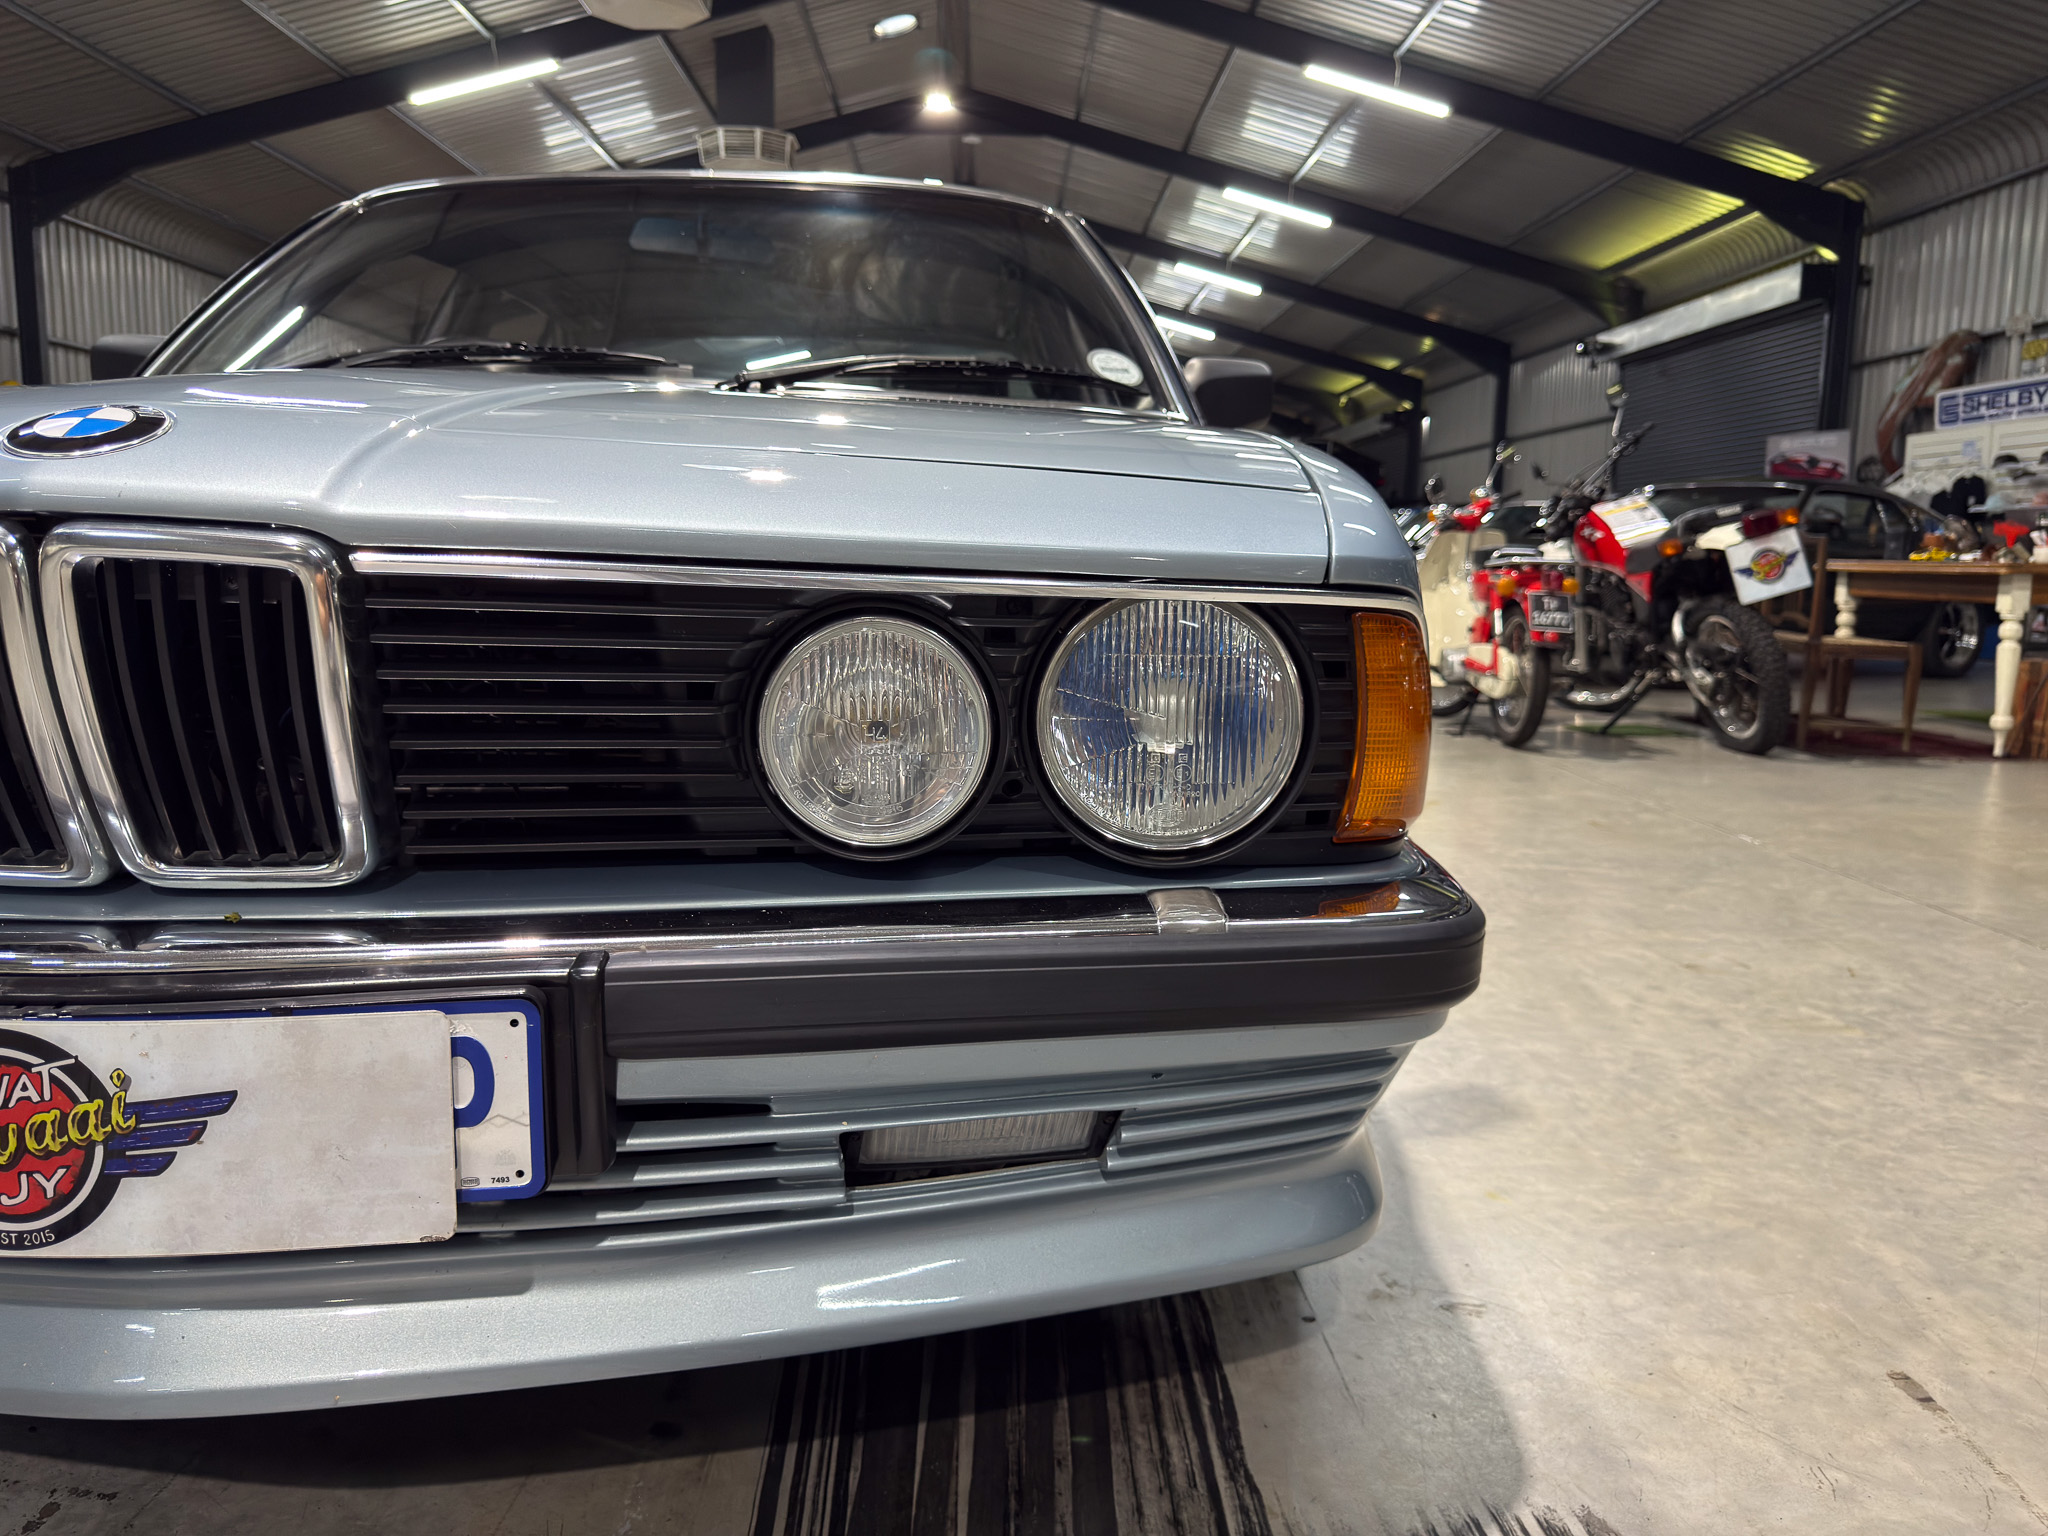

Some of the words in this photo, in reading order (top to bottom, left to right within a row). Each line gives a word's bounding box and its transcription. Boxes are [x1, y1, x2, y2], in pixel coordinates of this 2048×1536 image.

[1962, 386, 2048, 415] SHELBY
[1, 1168, 68, 1206] JY
[490, 1176, 510, 1184] 7493
[23, 1229, 56, 1246] 2015
